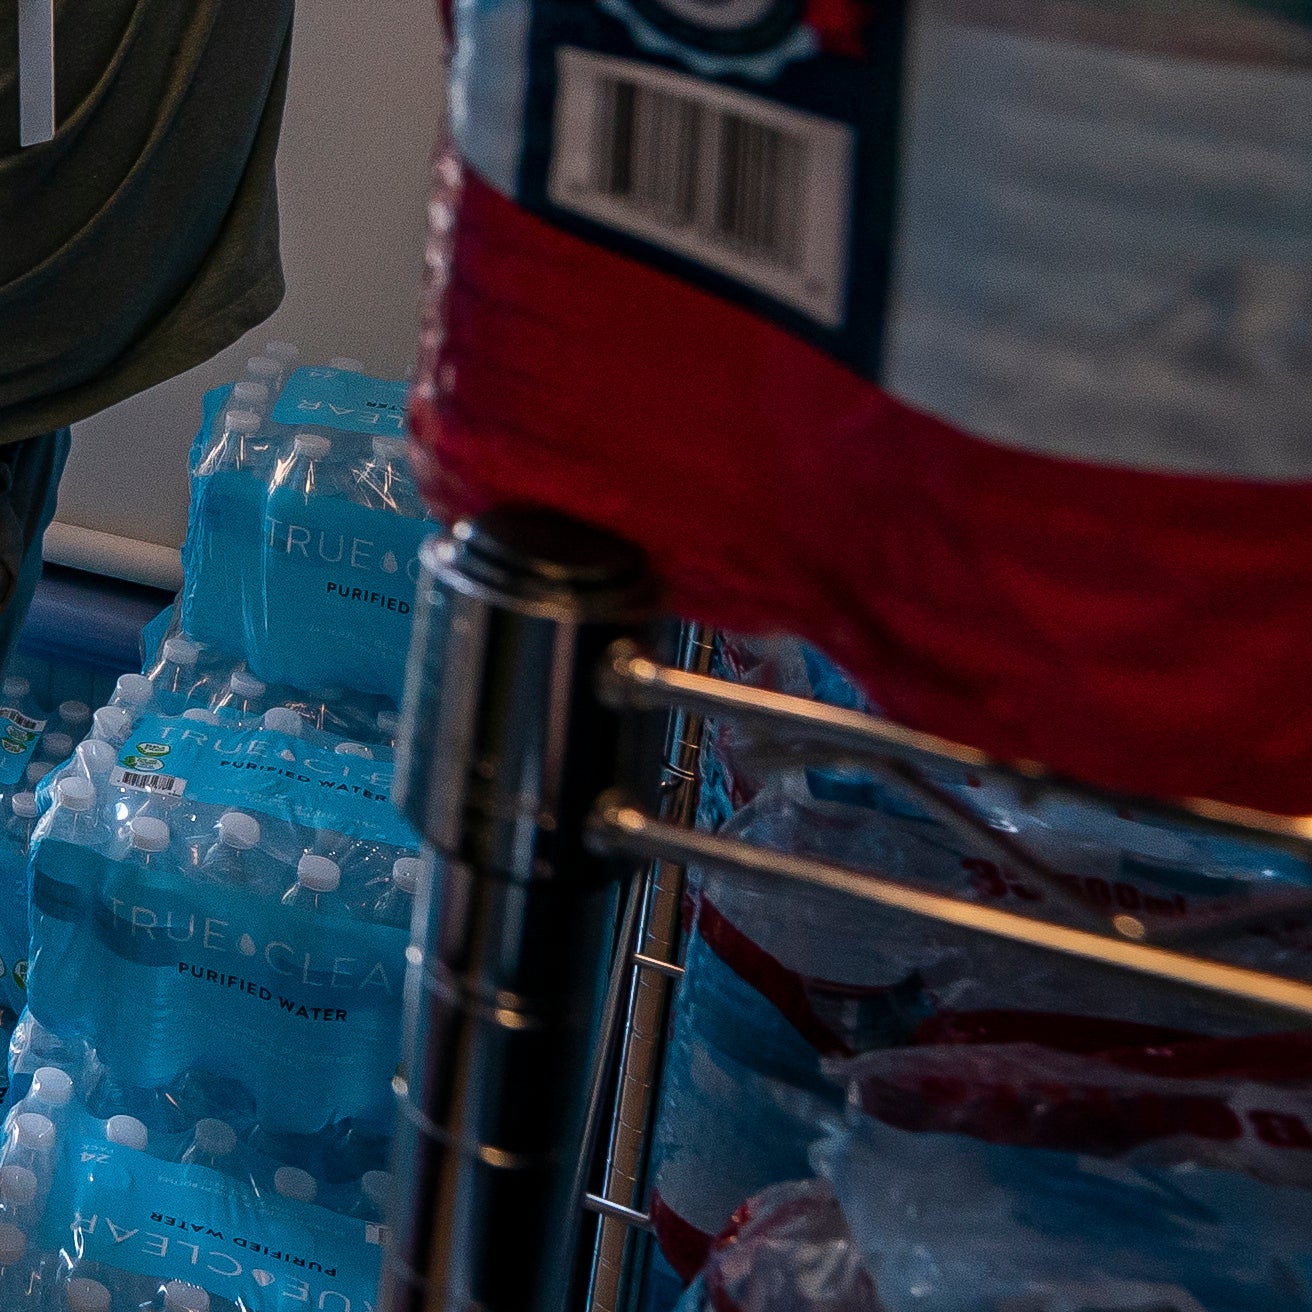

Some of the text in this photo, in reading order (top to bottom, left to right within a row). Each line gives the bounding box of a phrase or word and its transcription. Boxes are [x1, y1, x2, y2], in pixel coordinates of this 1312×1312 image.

[266, 515, 373, 571] TRUE
[326, 581, 411, 616] PURIFIED
[220, 759, 310, 786] PURIFIED
[319, 778, 387, 804] WATER
[108, 897, 392, 993] TRUE CLEA
[177, 960, 349, 1023] PURIFIED WATER
[149, 1210, 337, 1278] PURIFIED WATER
